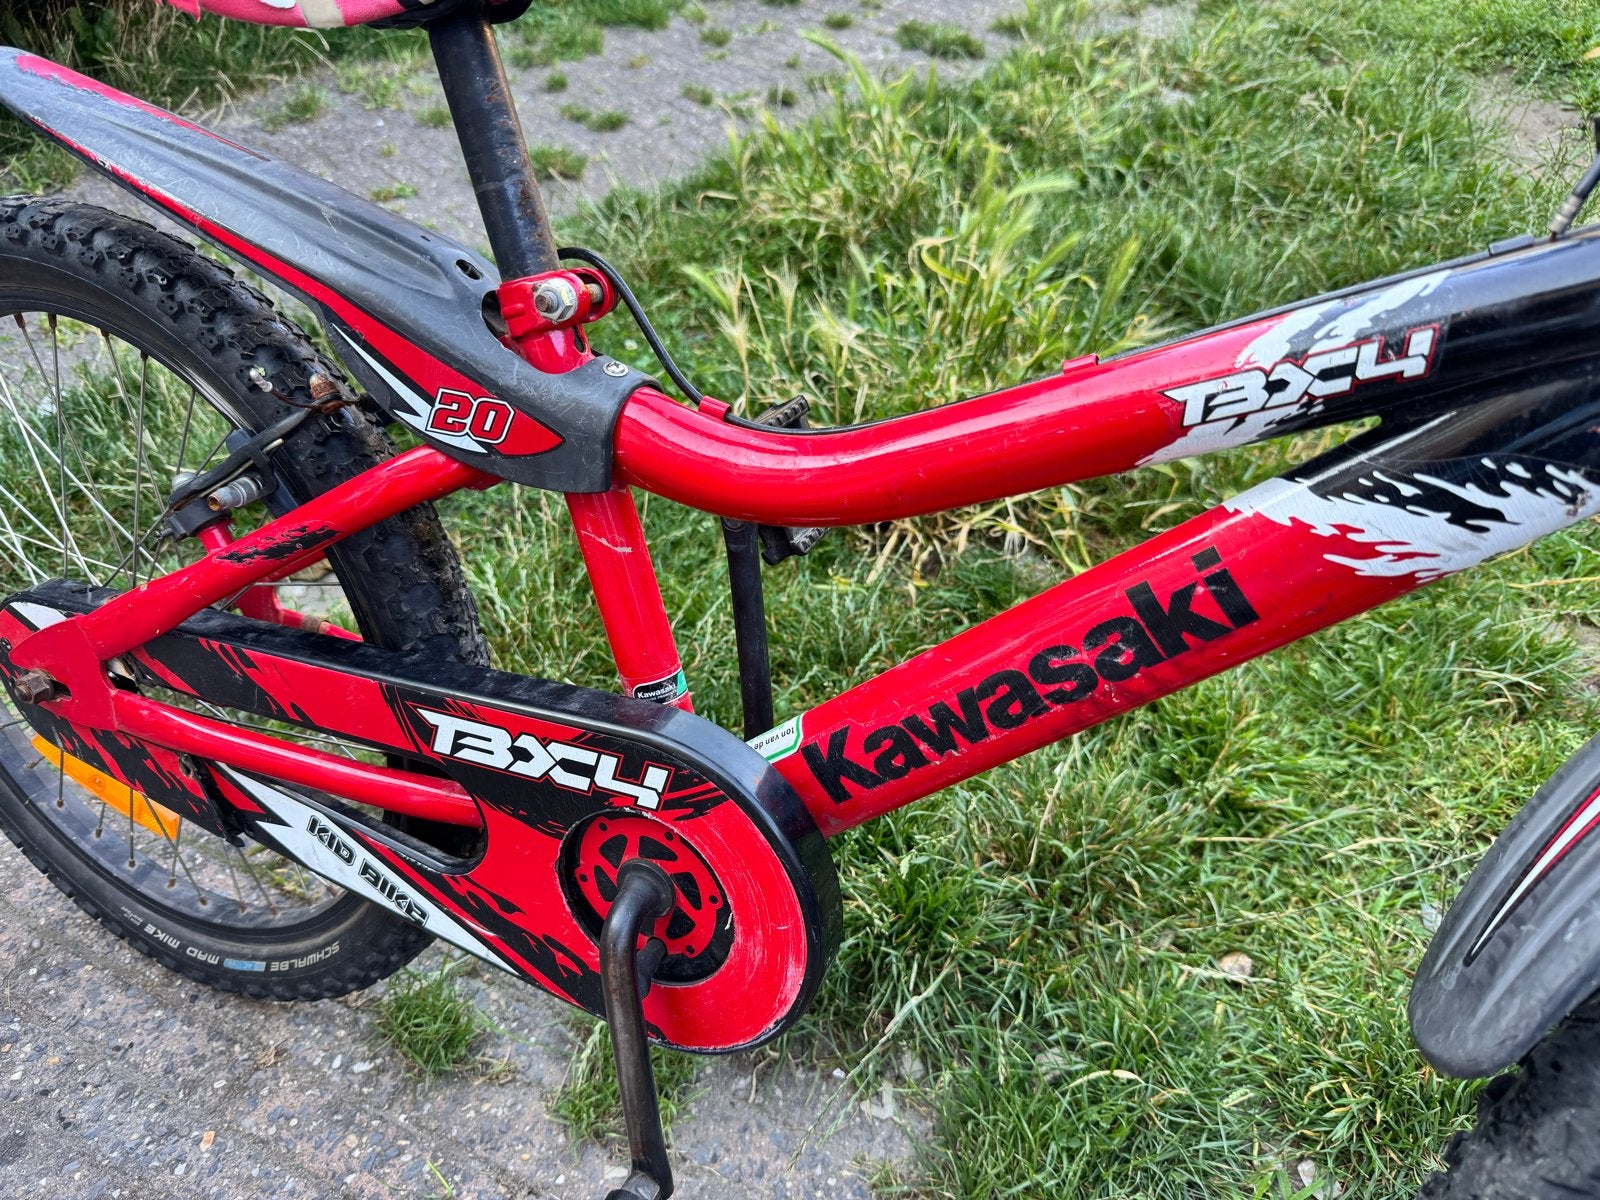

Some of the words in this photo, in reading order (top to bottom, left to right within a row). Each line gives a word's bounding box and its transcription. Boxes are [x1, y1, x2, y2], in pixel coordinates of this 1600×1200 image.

[425, 387, 515, 444] 20
[800, 546, 1260, 804] Kawasaki
[637, 682, 676, 699] Kawasaki
[765, 734, 780, 745] van
[306, 815, 357, 867] KID
[358, 858, 430, 928] BIKE
[143, 923, 181, 949] MIKE
[186, 946, 220, 965] MAD
[269, 941, 340, 972] SCHWALBE
